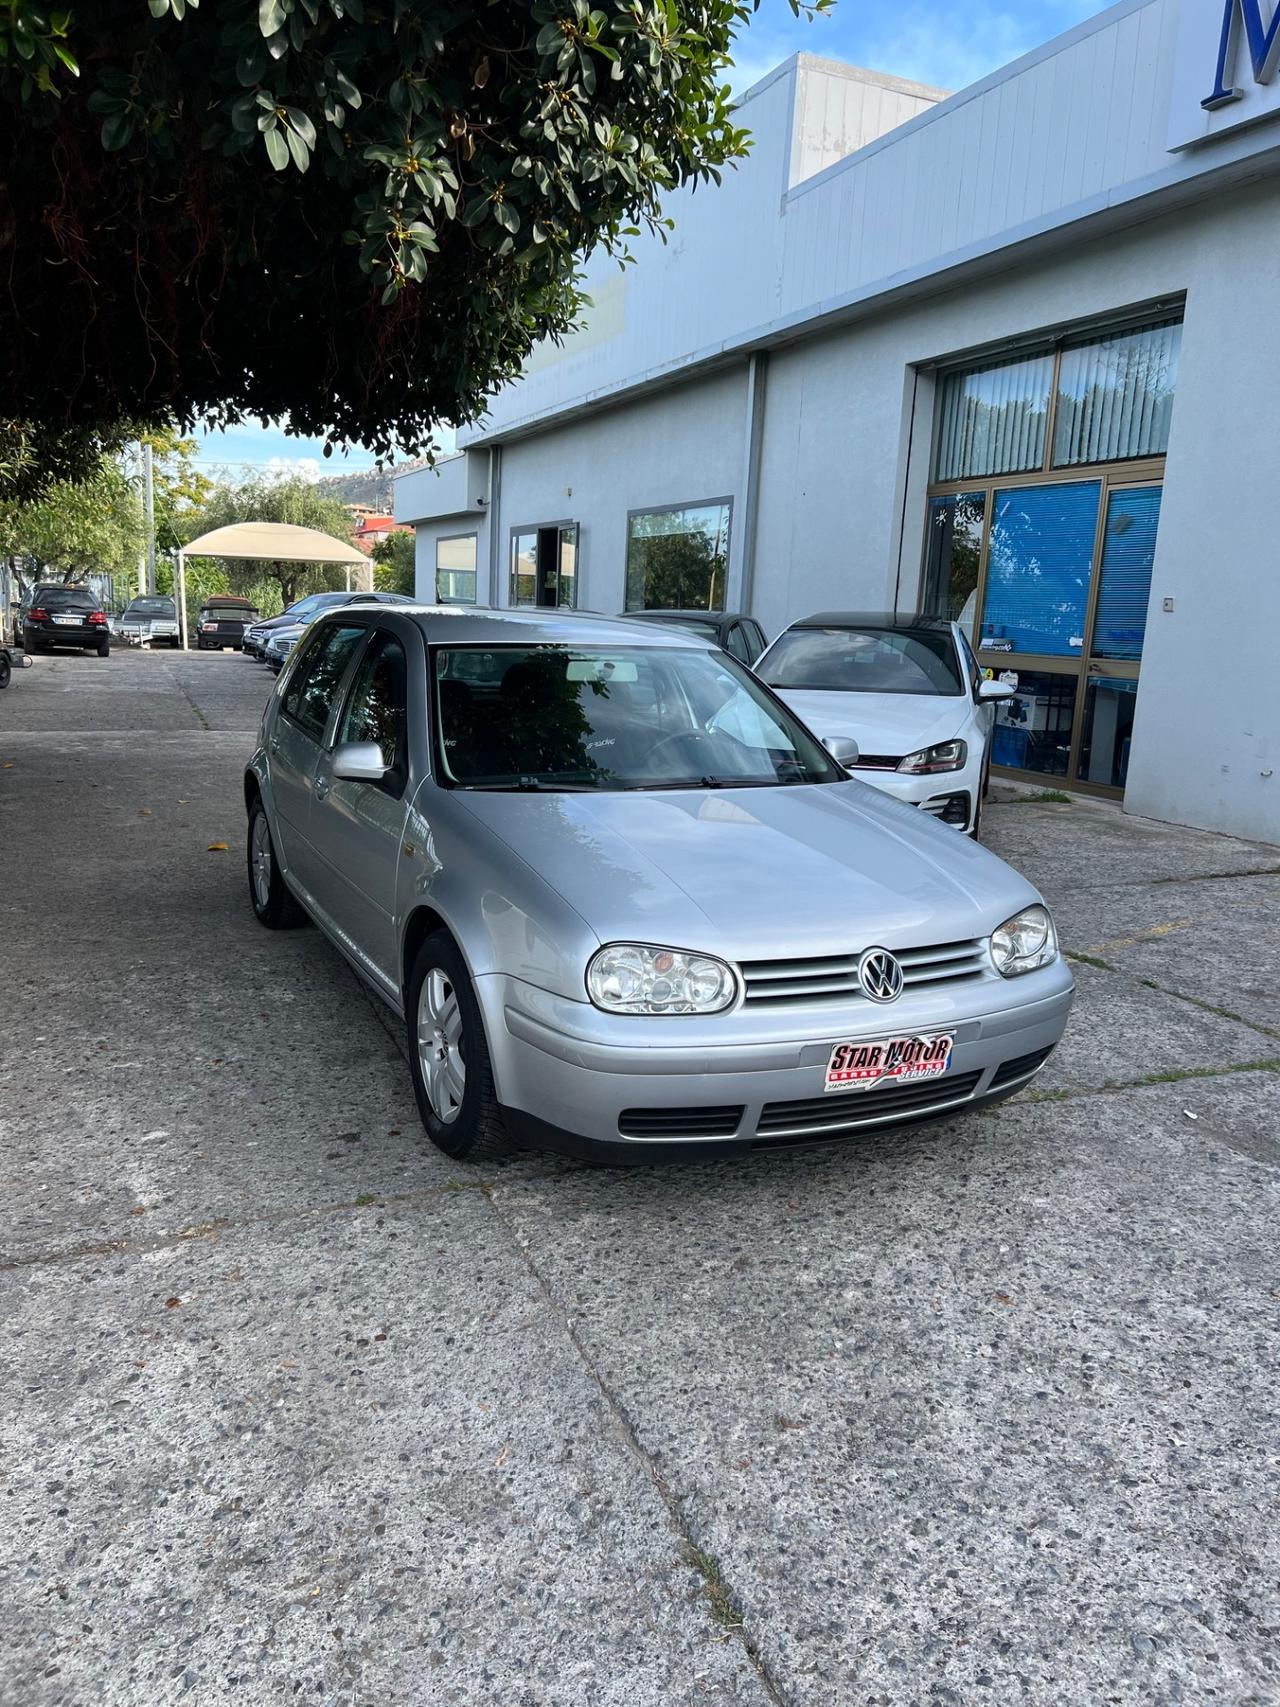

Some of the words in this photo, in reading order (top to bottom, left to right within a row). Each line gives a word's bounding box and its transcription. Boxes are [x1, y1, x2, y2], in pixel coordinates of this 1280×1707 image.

[831, 1044, 882, 1070] STAR
[884, 1039, 949, 1065] MOTOR
[830, 1069, 886, 1081] GARAG
[900, 1068, 941, 1080] SERVICE
